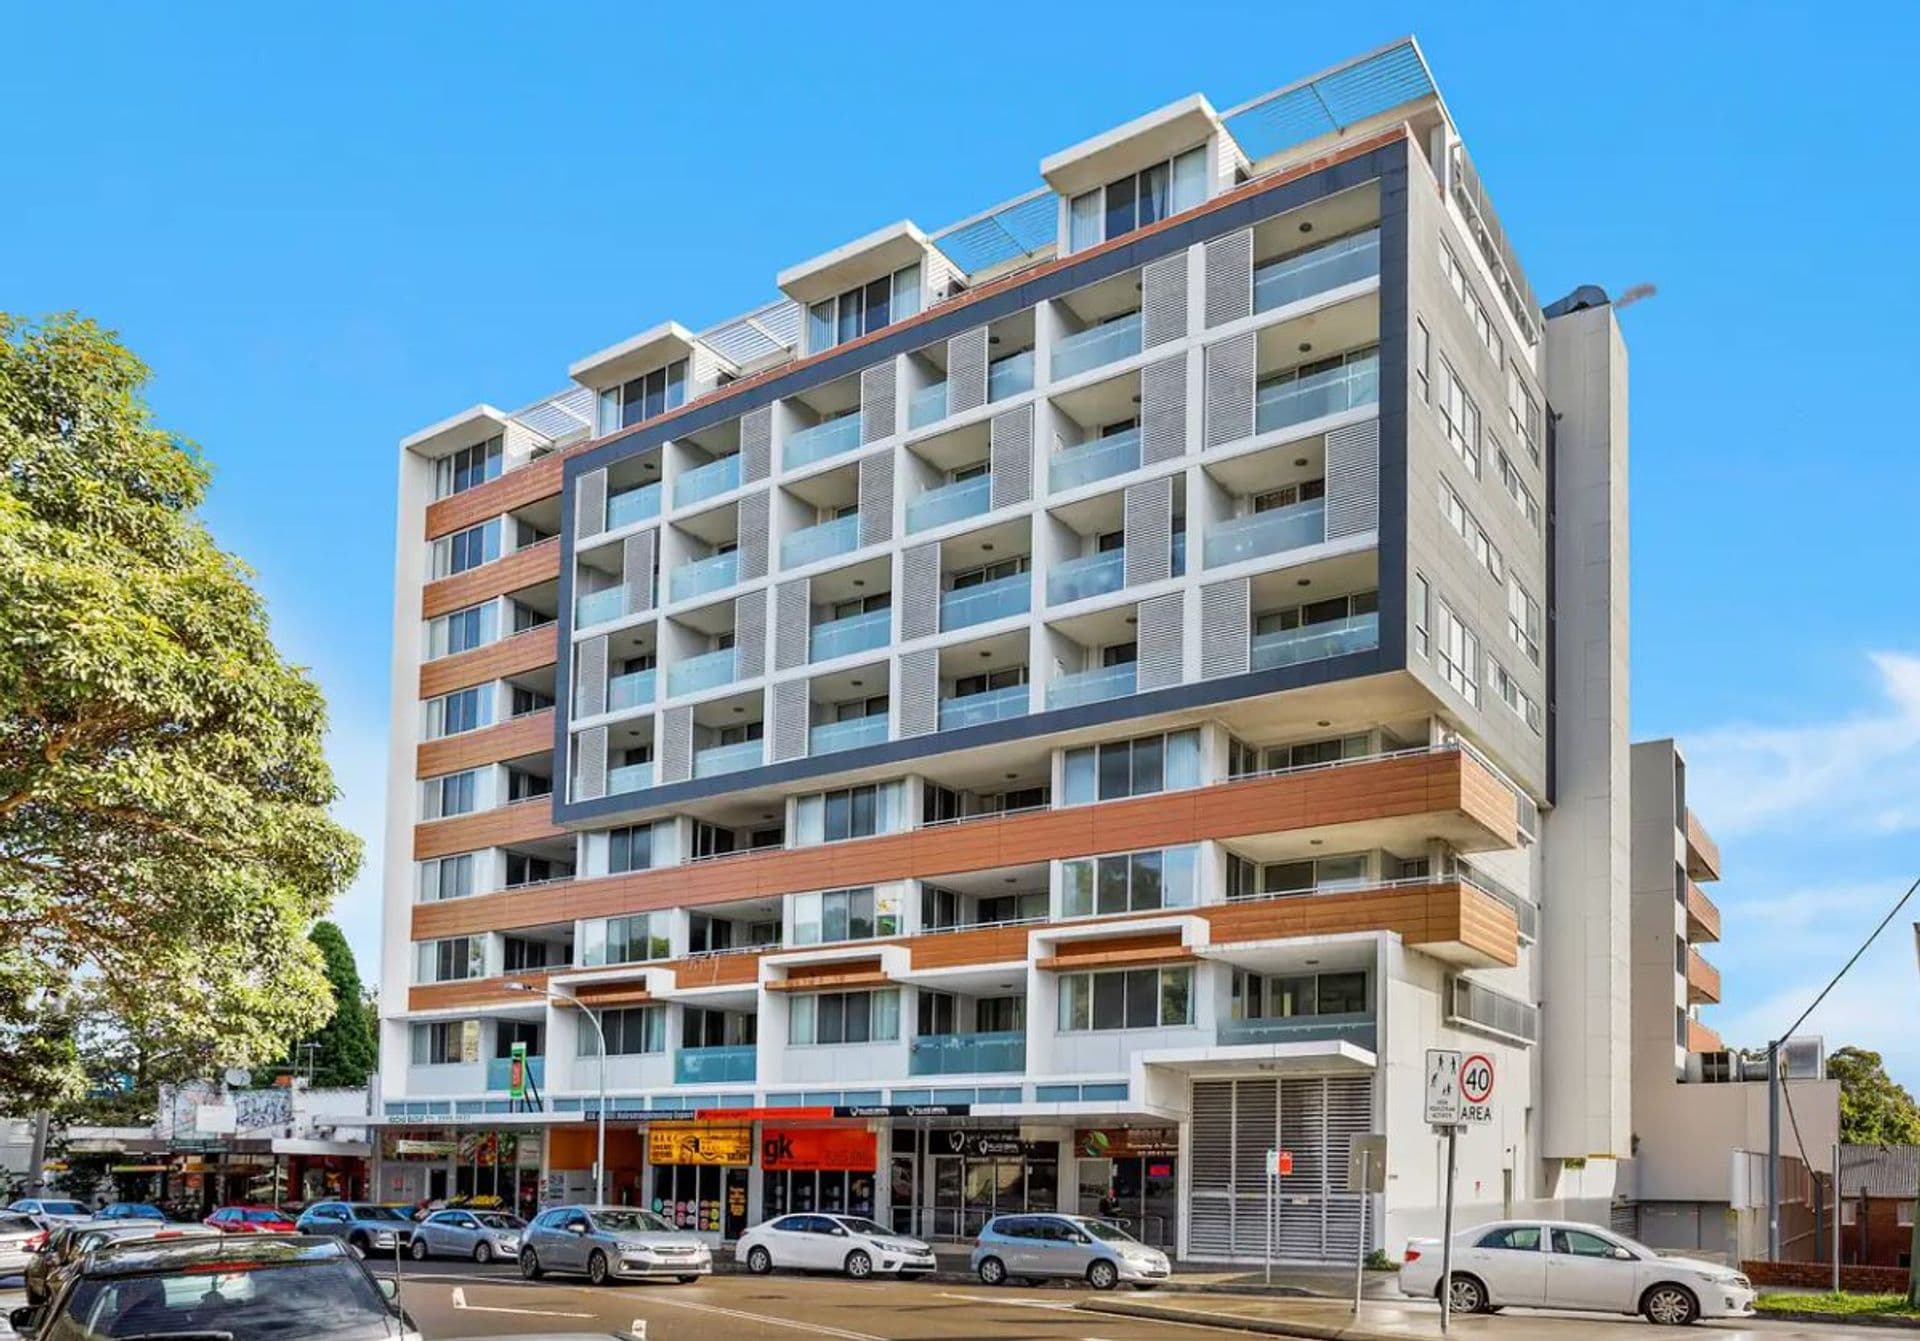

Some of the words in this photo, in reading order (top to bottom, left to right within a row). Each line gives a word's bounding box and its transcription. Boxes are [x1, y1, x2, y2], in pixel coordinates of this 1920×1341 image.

[1466, 1068, 1490, 1091] 40
[1461, 1106, 1491, 1120] AREA
[764, 1133, 794, 1164] gk
